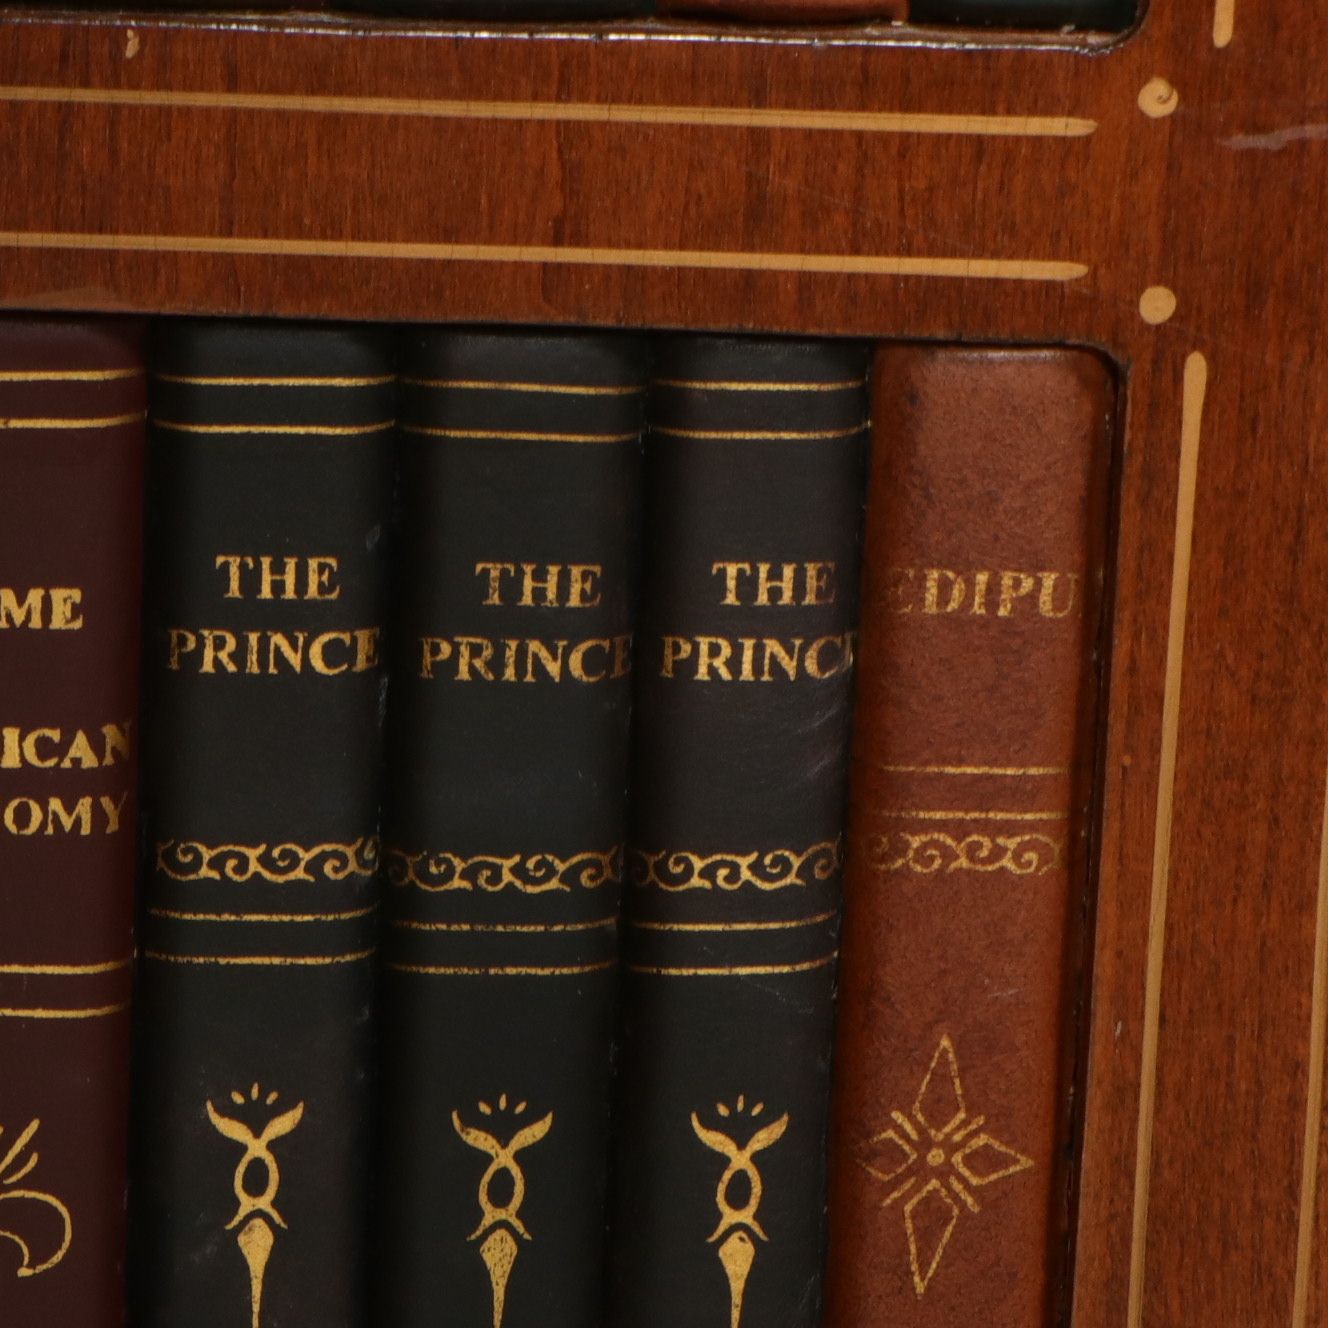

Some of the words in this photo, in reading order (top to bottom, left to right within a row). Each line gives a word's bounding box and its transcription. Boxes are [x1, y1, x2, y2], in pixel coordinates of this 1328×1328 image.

[215, 555, 341, 600] THE
[475, 562, 602, 608] THE
[712, 561, 836, 607] THE
[168, 627, 380, 675] PRINCE
